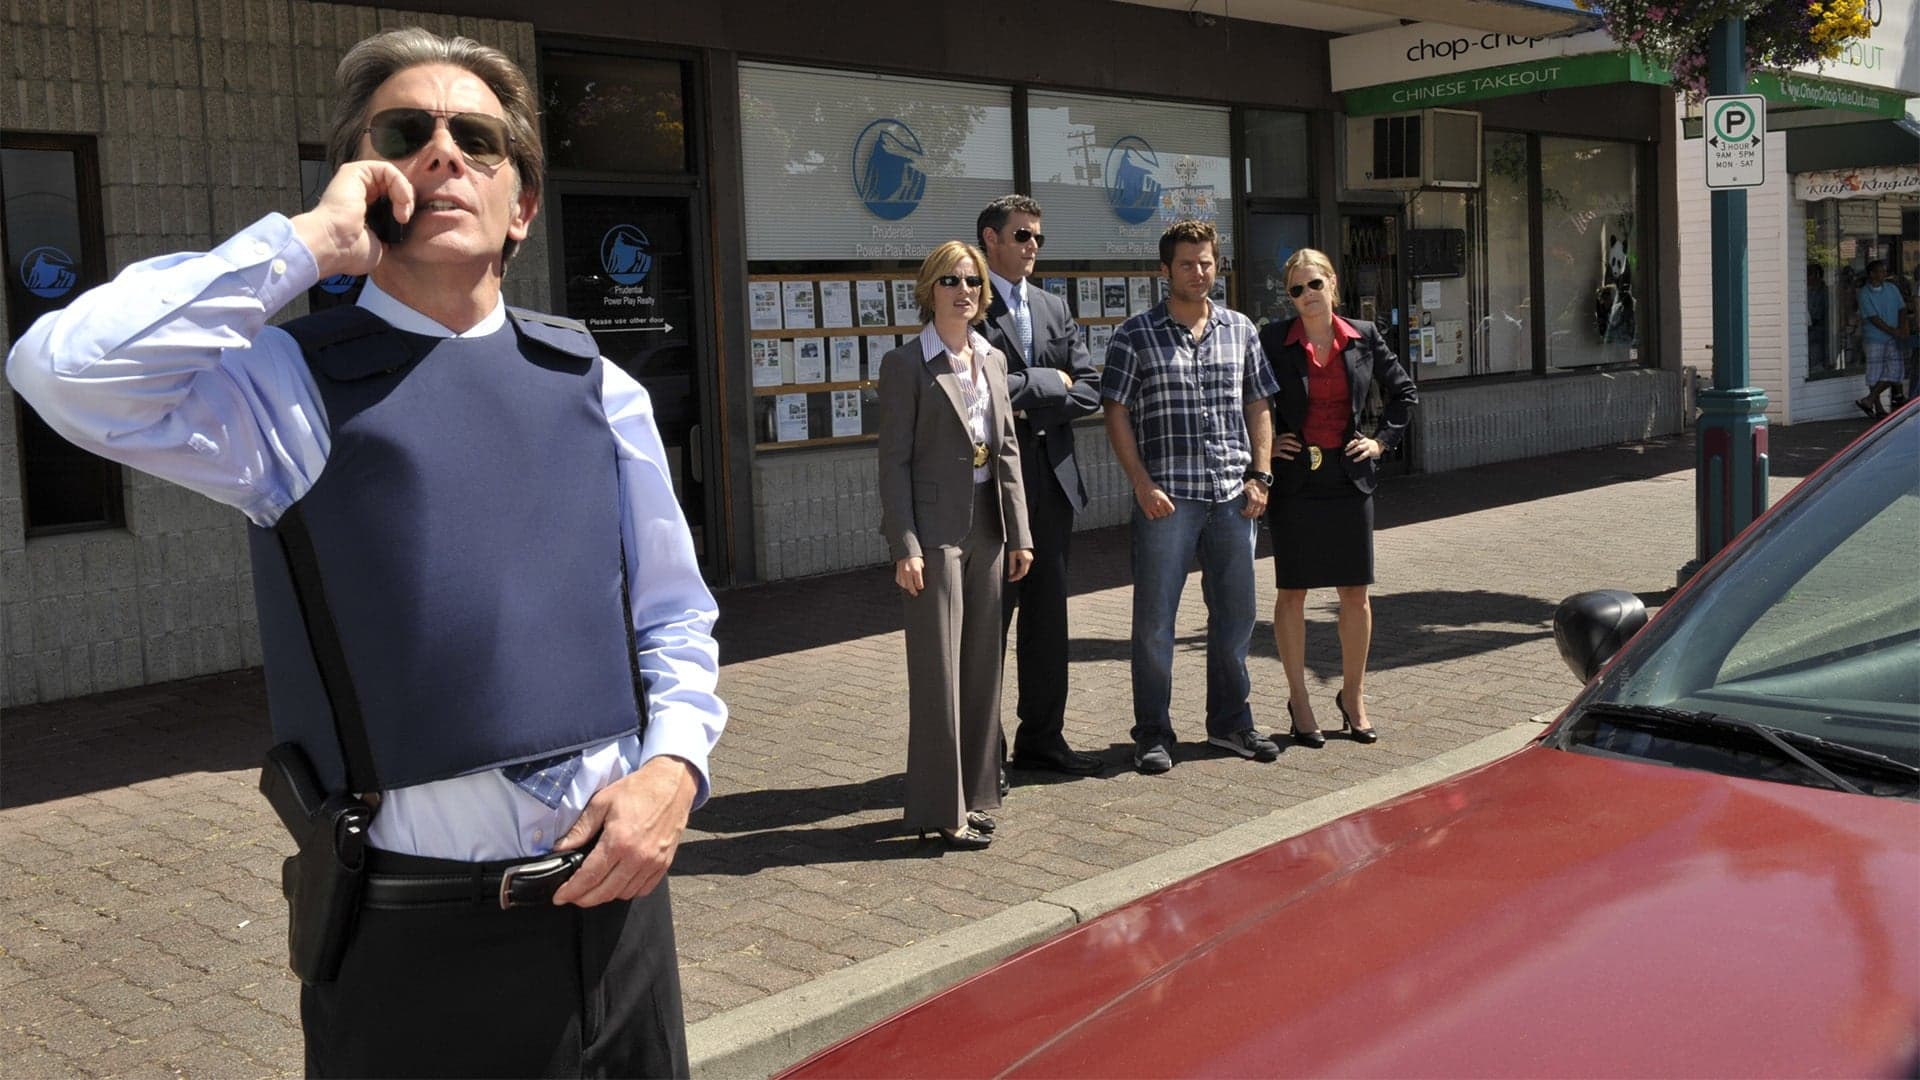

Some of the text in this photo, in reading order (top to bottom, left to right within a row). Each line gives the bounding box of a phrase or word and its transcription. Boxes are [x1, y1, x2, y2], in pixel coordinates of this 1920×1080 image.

[1392, 67, 1561, 103] CHINESE TAKEOUT
[1727, 111, 1746, 134] P
[1721, 142, 1750, 151] 3 HOUR
[1738, 151, 1755, 159] 5PM
[1740, 160, 1754, 168] SAT
[856, 243, 882, 257] Power
